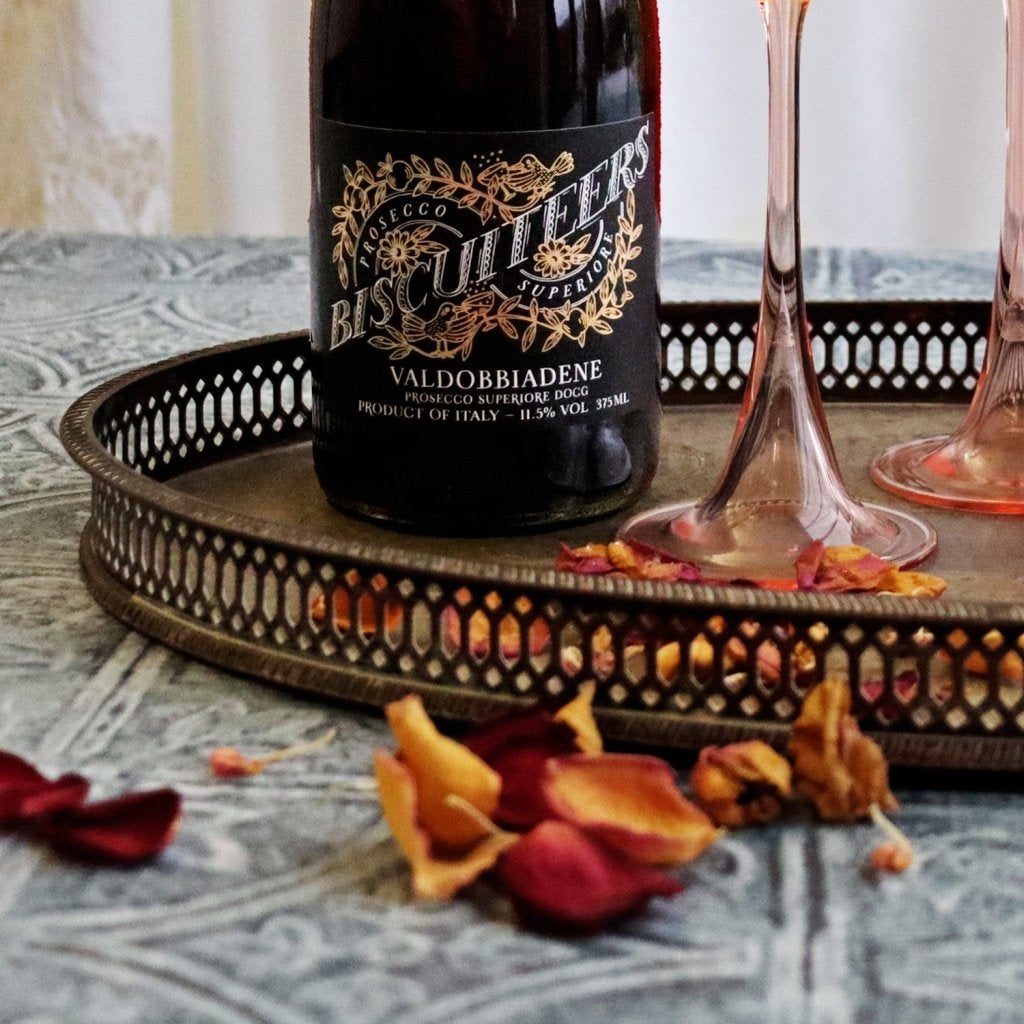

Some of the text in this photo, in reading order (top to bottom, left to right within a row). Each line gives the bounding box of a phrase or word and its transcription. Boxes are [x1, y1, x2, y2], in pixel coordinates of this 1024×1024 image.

[330, 122, 650, 351] BISCUITEERS
[360, 202, 448, 268] PROSECCO
[517, 232, 613, 300] SUPERIORE
[390, 359, 602, 389] VALDOBBIADENE
[404, 387, 589, 405] PROSECCO SUPERIORE DOCG
[357, 400, 422, 420] PRODUCT
[429, 409, 450, 421] OF
[455, 409, 499, 422] ITALY
[519, 405, 556, 421] 11.5%
[559, 401, 589, 416] VOL
